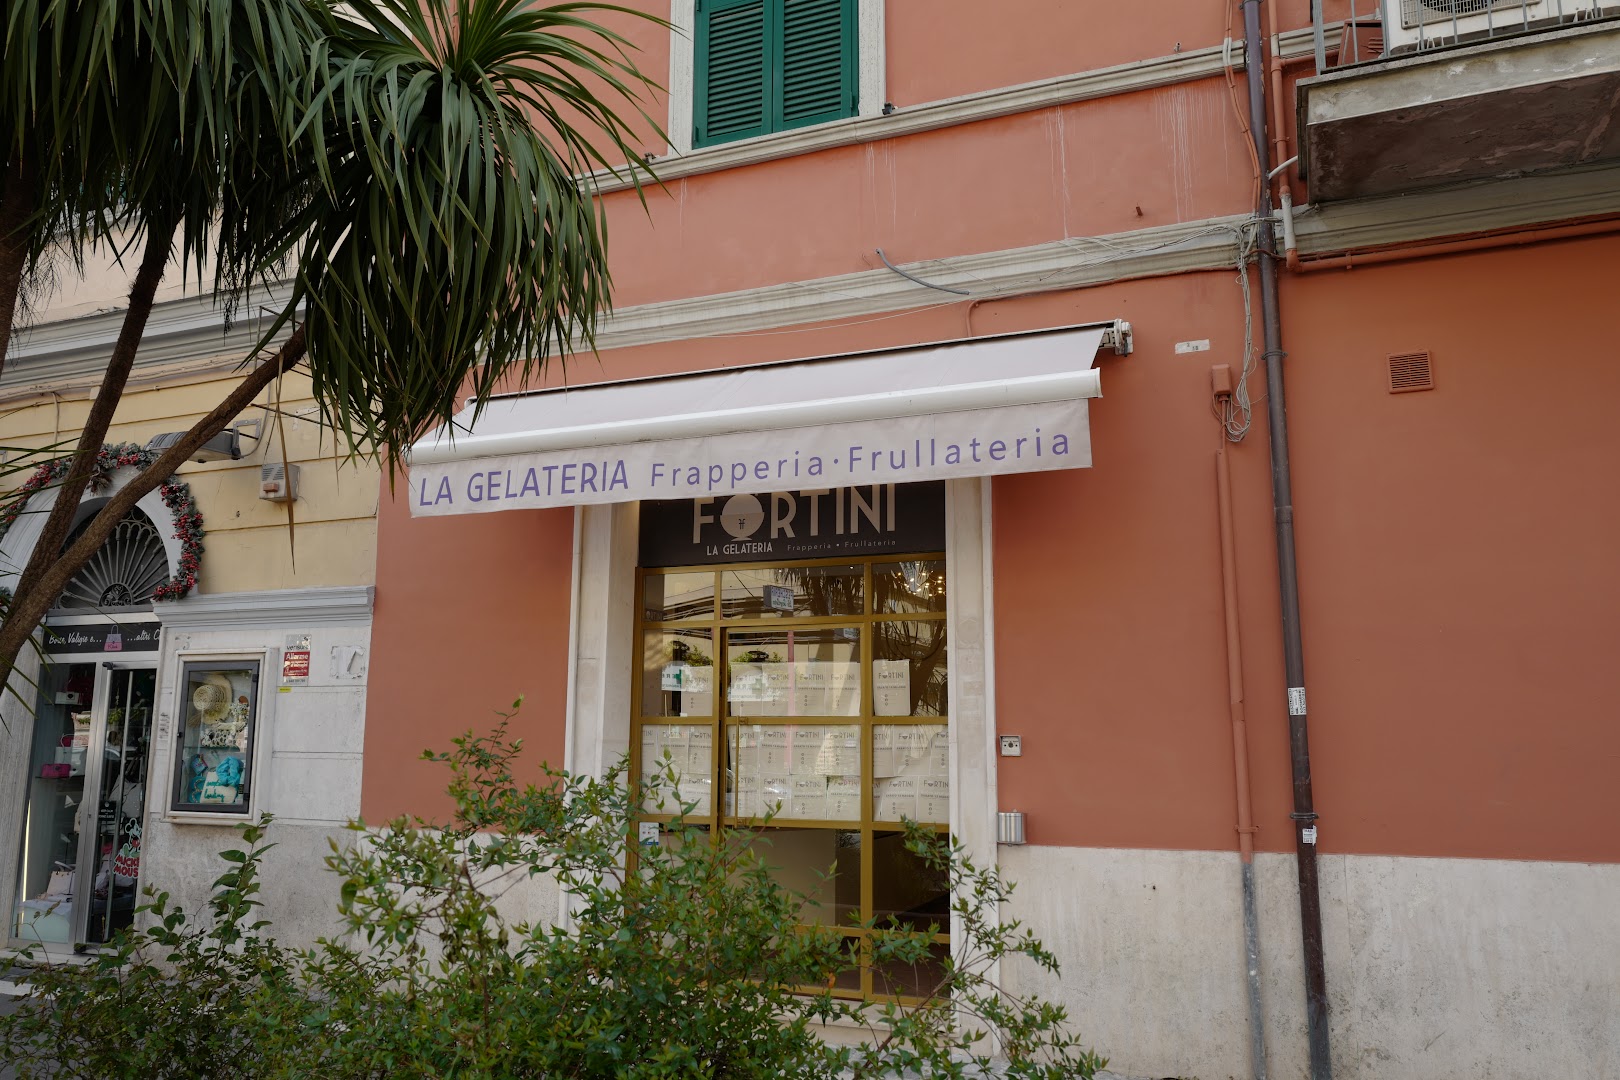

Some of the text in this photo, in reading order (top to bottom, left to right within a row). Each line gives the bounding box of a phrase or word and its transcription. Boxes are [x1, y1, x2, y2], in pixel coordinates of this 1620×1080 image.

[419, 428, 1069, 506] LA GELATERIA Frapperia Frullateria
[706, 539, 896, 556] LA GELATERIA Frapperia Frullateria
